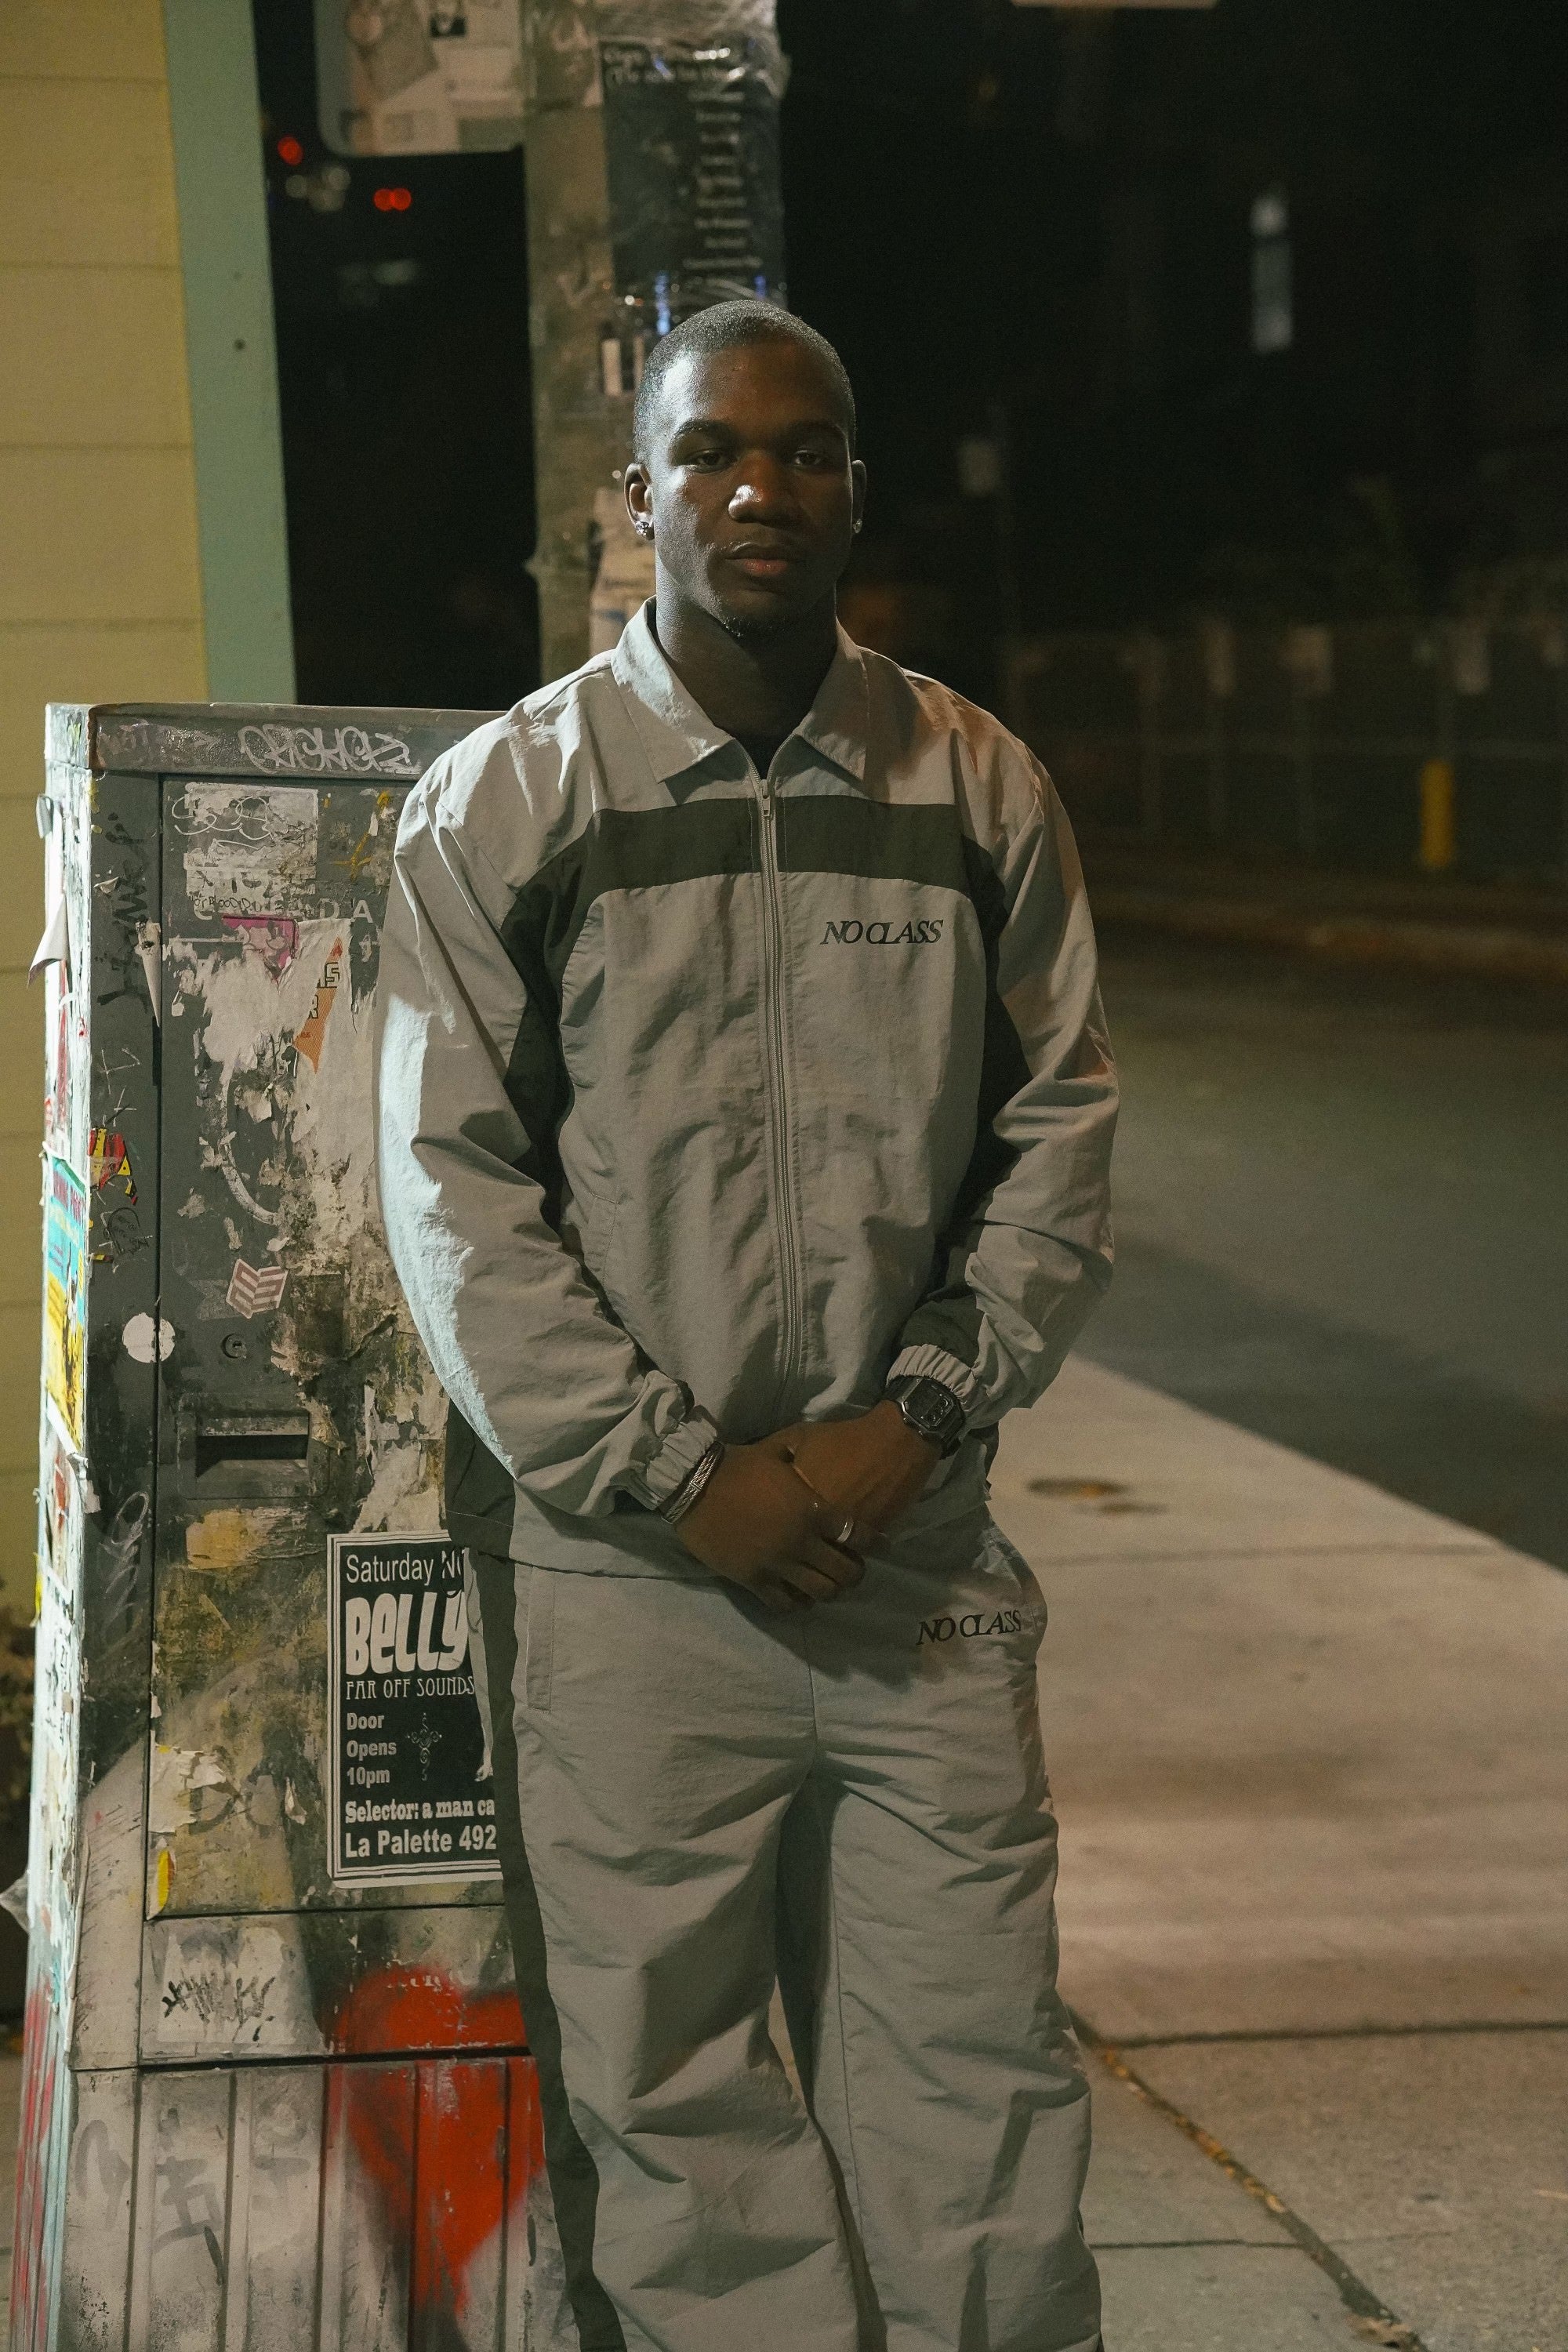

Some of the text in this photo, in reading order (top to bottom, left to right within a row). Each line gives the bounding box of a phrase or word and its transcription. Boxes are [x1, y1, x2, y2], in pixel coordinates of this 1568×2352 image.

[820, 920, 944, 945] NO CLASS
[346, 1552, 434, 1586] Saturday
[916, 1609, 1022, 1646] NO CLASS
[346, 1675, 475, 1700] FAR OFF SOUNDS
[347, 1712, 385, 1730] Door
[346, 1740, 397, 1762] Opens
[347, 1766, 390, 1788] 10pm
[345, 1798, 419, 1824] Selector:
[422, 1802, 433, 1820] a
[435, 1800, 474, 1818] man
[345, 1824, 497, 1858] La Palette 492
